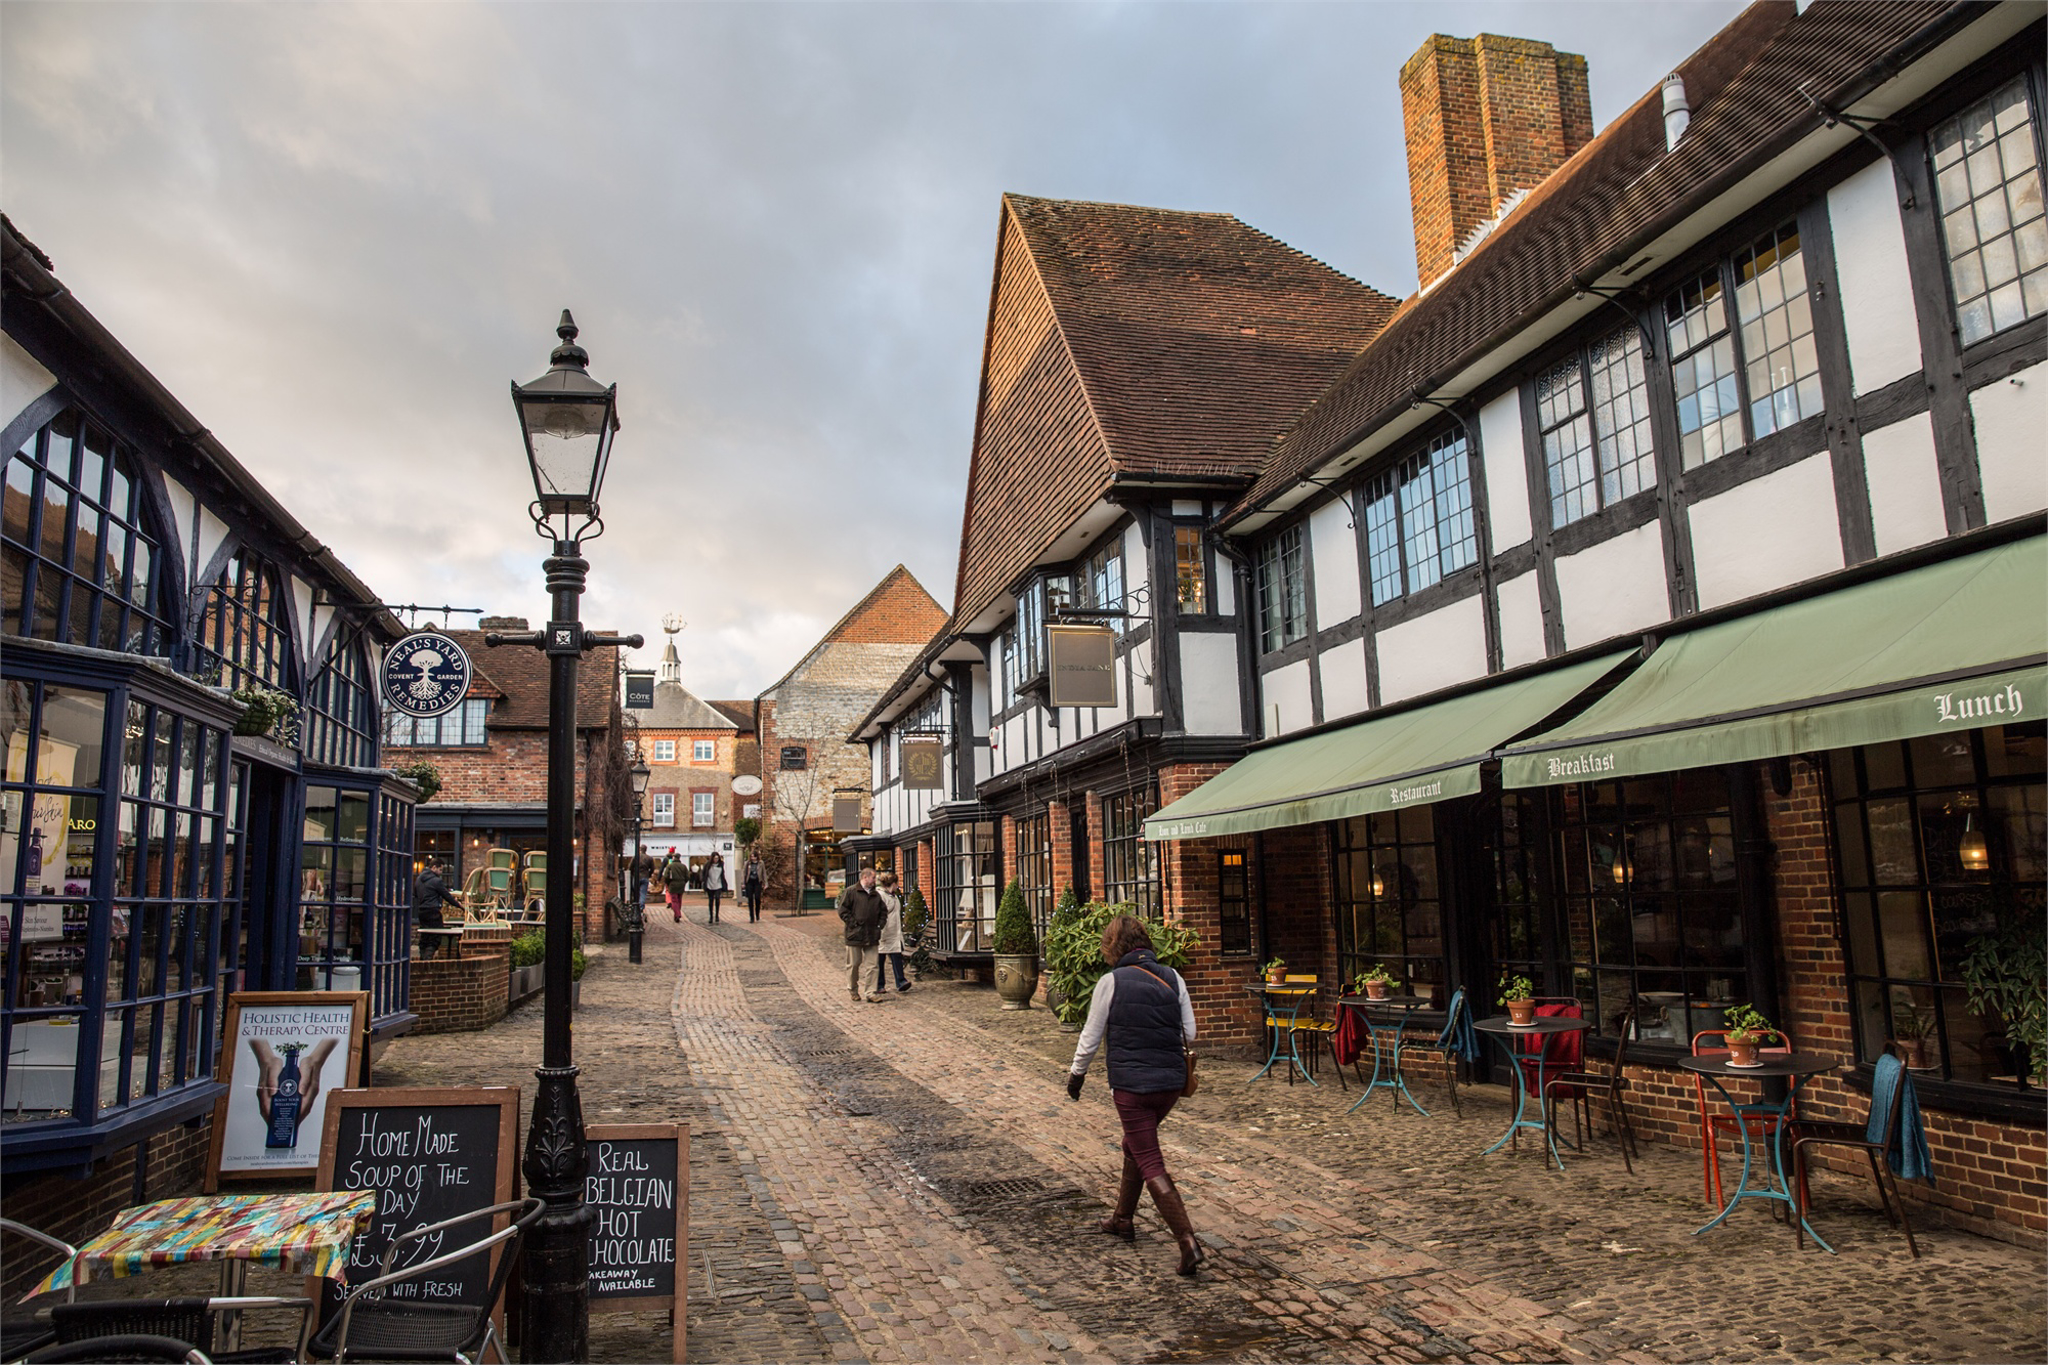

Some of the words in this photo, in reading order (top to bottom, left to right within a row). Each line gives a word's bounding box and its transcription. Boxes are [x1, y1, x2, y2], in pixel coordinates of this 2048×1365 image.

[389, 638, 432, 671] NEAL'S
[435, 640, 464, 671] YARD
[390, 683, 461, 711] REMEDIES
[629, 692, 651, 700] CÔTE
[1933, 683, 2024, 724] Lunch
[1547, 753, 1616, 780] Breakfast
[1390, 780, 1443, 804] Restaurant
[241, 1027, 251, 1036] &
[251, 1025, 304, 1036] THERAPY
[304, 1024, 349, 1035] CENTRE
[243, 1012, 302, 1024] HOLISTIC
[303, 1012, 350, 1024] HEALTH
[355, 1112, 411, 1157] HOME
[413, 1115, 460, 1157] MADE
[598, 1142, 649, 1173] REAL
[345, 1160, 402, 1189] SOUP
[404, 1164, 427, 1191] OF
[437, 1163, 470, 1187] THE
[381, 1189, 421, 1220] DAY
[585, 1176, 672, 1209] BELGIAN
[597, 1208, 642, 1238] HOT
[588, 1269, 639, 1280] AKEAWAY
[599, 1278, 656, 1292] AVAILABLE
[392, 1283, 418, 1297] WITH
[422, 1281, 463, 1299] FRESH
